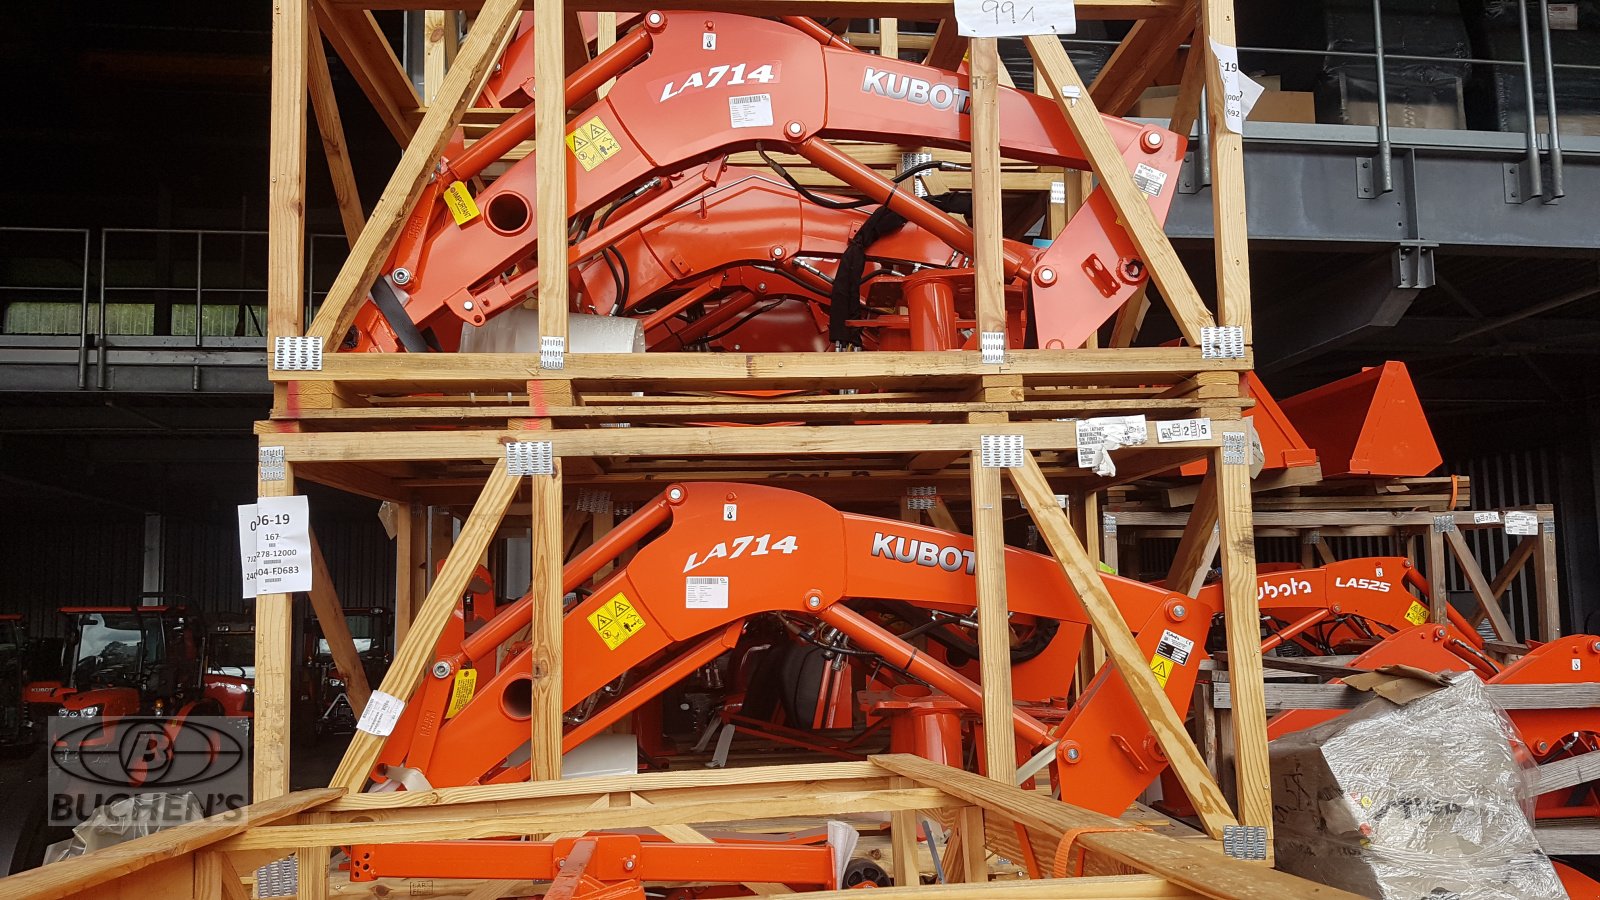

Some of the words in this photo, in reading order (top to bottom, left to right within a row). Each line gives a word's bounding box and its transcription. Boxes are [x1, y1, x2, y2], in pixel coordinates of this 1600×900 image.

[659, 63, 775, 102] LA714
[861, 66, 971, 113] KUBOT
[1201, 424, 1207, 435] 5
[265, 533, 279, 541] 167
[682, 533, 799, 573] LA714
[871, 532, 976, 576] KUBOT
[1257, 577, 1312, 600] ubota
[1335, 577, 1392, 593] LA525
